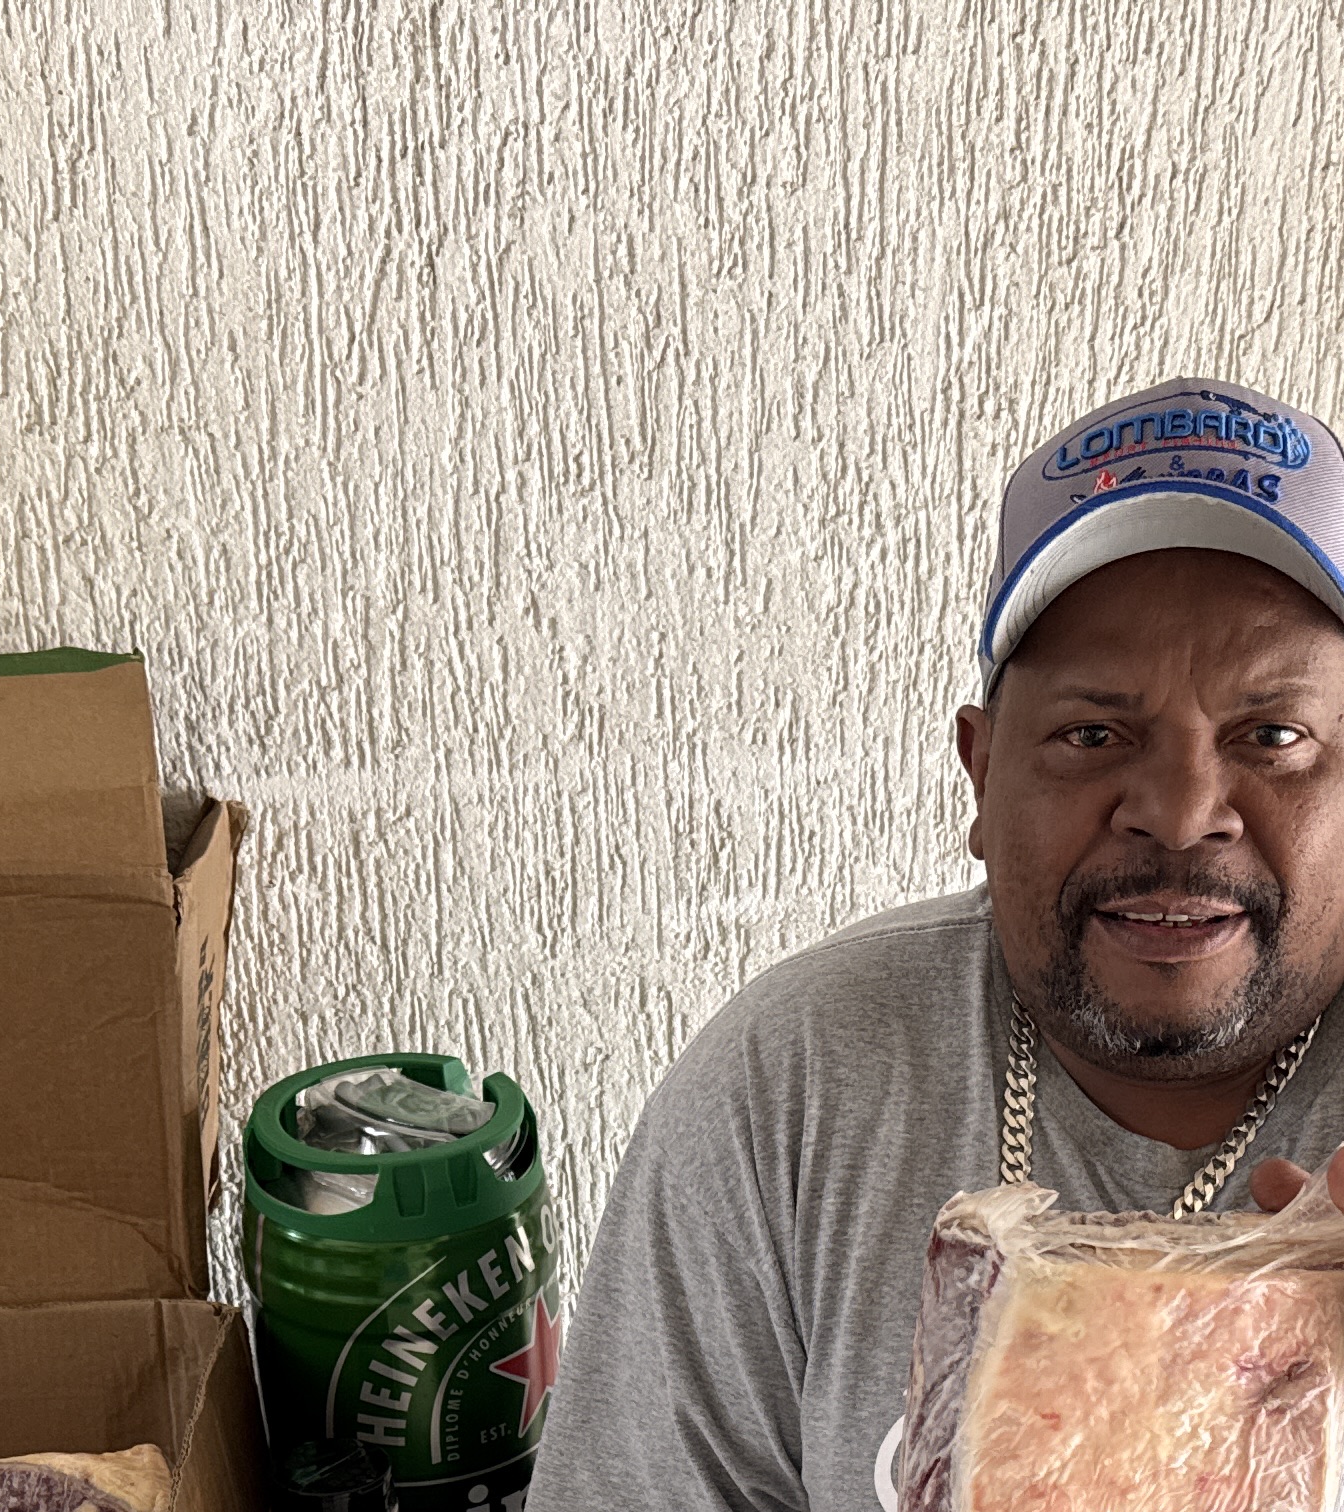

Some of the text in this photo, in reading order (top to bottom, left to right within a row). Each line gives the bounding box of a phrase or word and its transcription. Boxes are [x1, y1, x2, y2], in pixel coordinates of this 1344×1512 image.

[356, 1225, 536, 1448] HEINEKEN
[446, 1297, 533, 1462] DIPLOME D'HONNEUR
[480, 1422, 512, 1444] EST.
